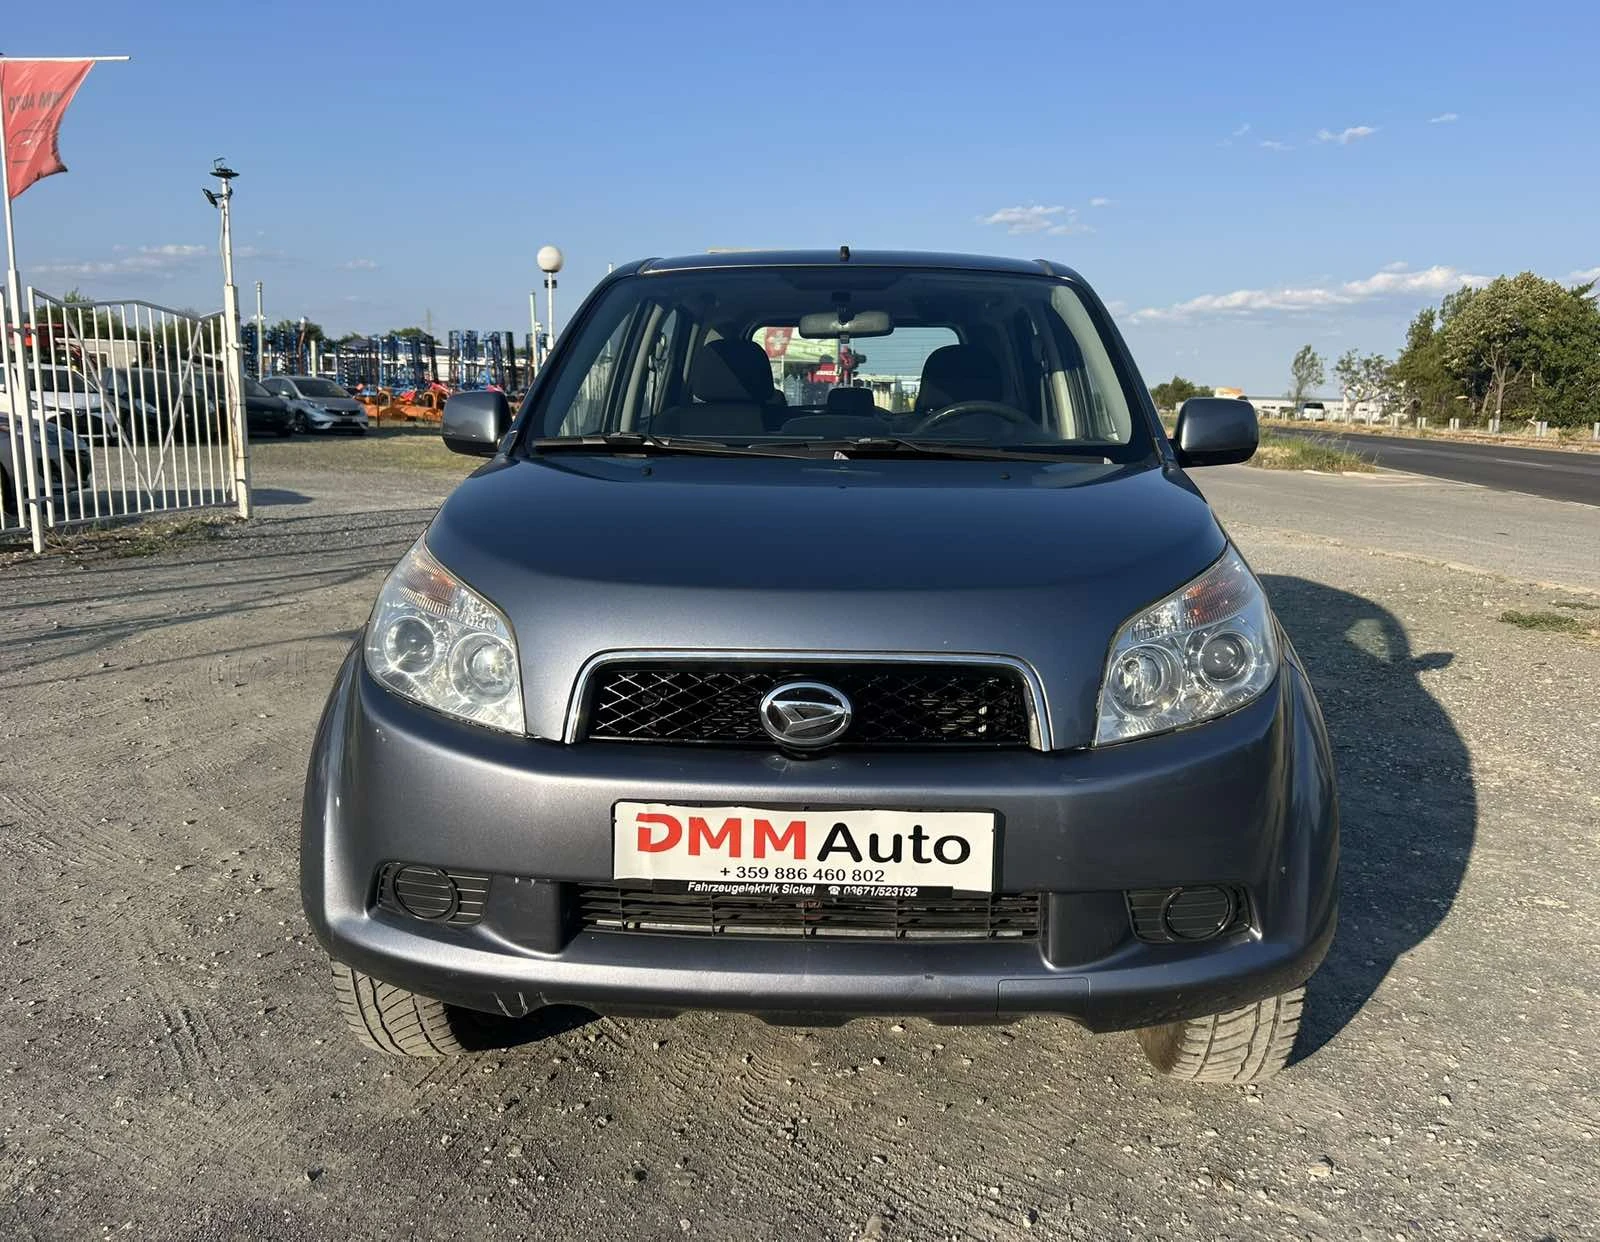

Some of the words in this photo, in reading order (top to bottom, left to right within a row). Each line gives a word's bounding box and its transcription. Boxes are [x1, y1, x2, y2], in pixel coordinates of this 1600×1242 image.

[636, 813, 806, 860] DMM
[817, 822, 971, 865] Auto
[736, 866, 769, 879] 359
[774, 868, 808, 880] 886
[813, 868, 846, 881] 460
[852, 869, 885, 882] 802
[781, 885, 816, 895] Sickel
